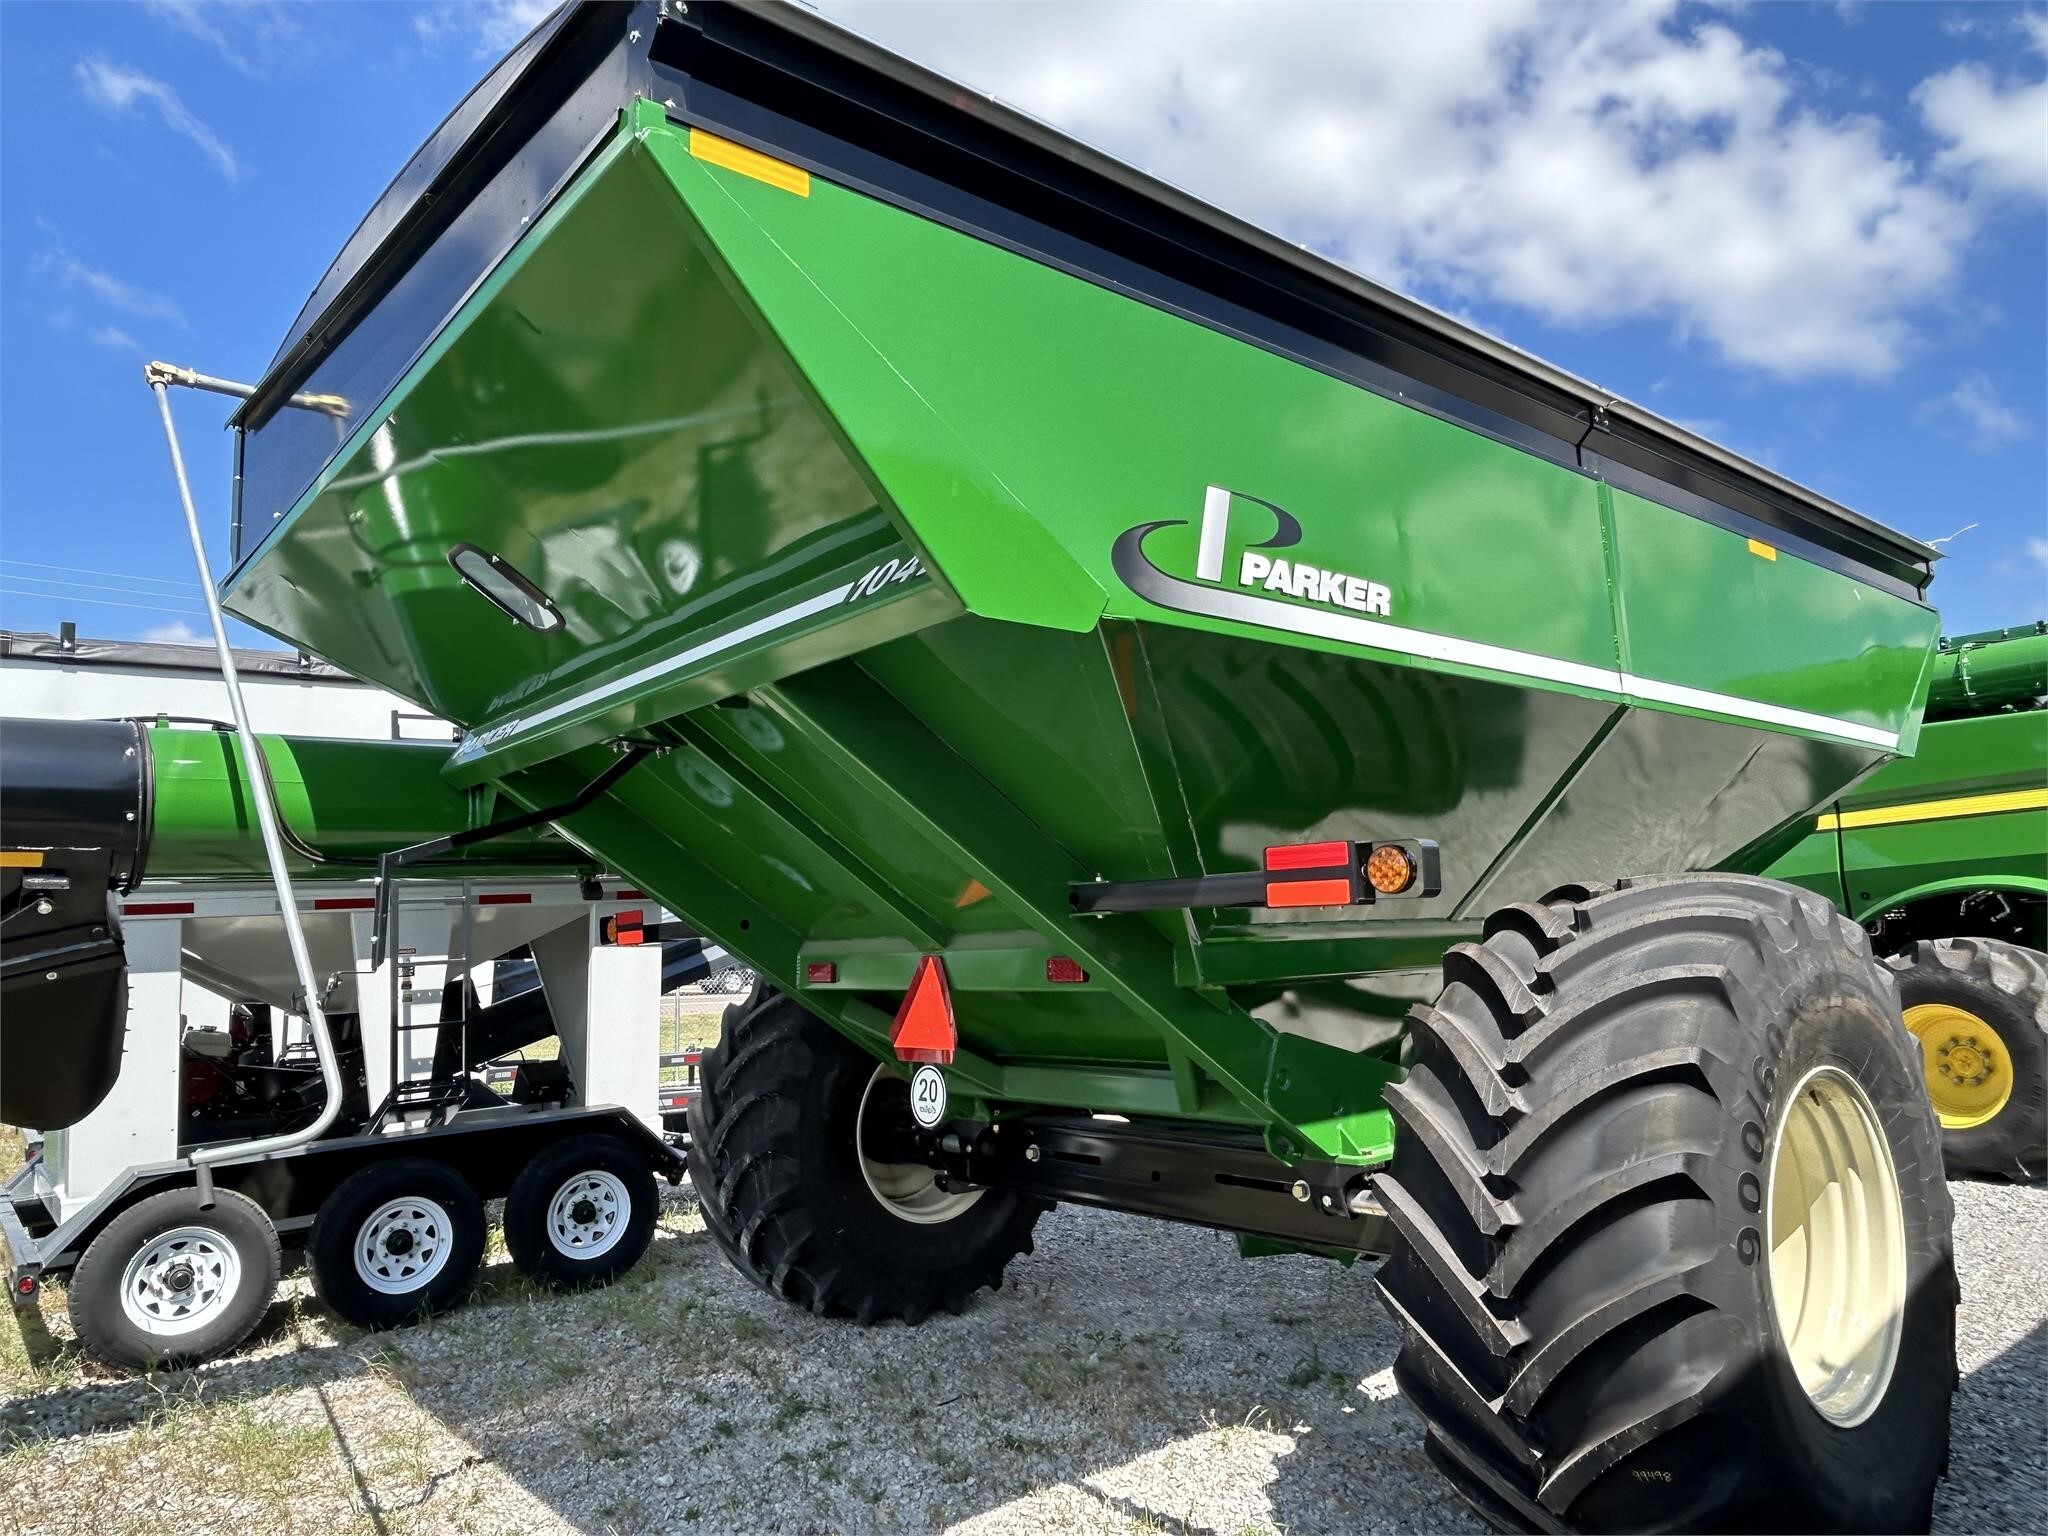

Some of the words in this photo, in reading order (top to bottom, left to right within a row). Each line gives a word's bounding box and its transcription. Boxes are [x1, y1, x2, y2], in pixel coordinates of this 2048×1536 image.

[849, 555, 928, 602] 104
[1239, 551, 1391, 617] PARKER
[918, 1078, 938, 1103] 20
